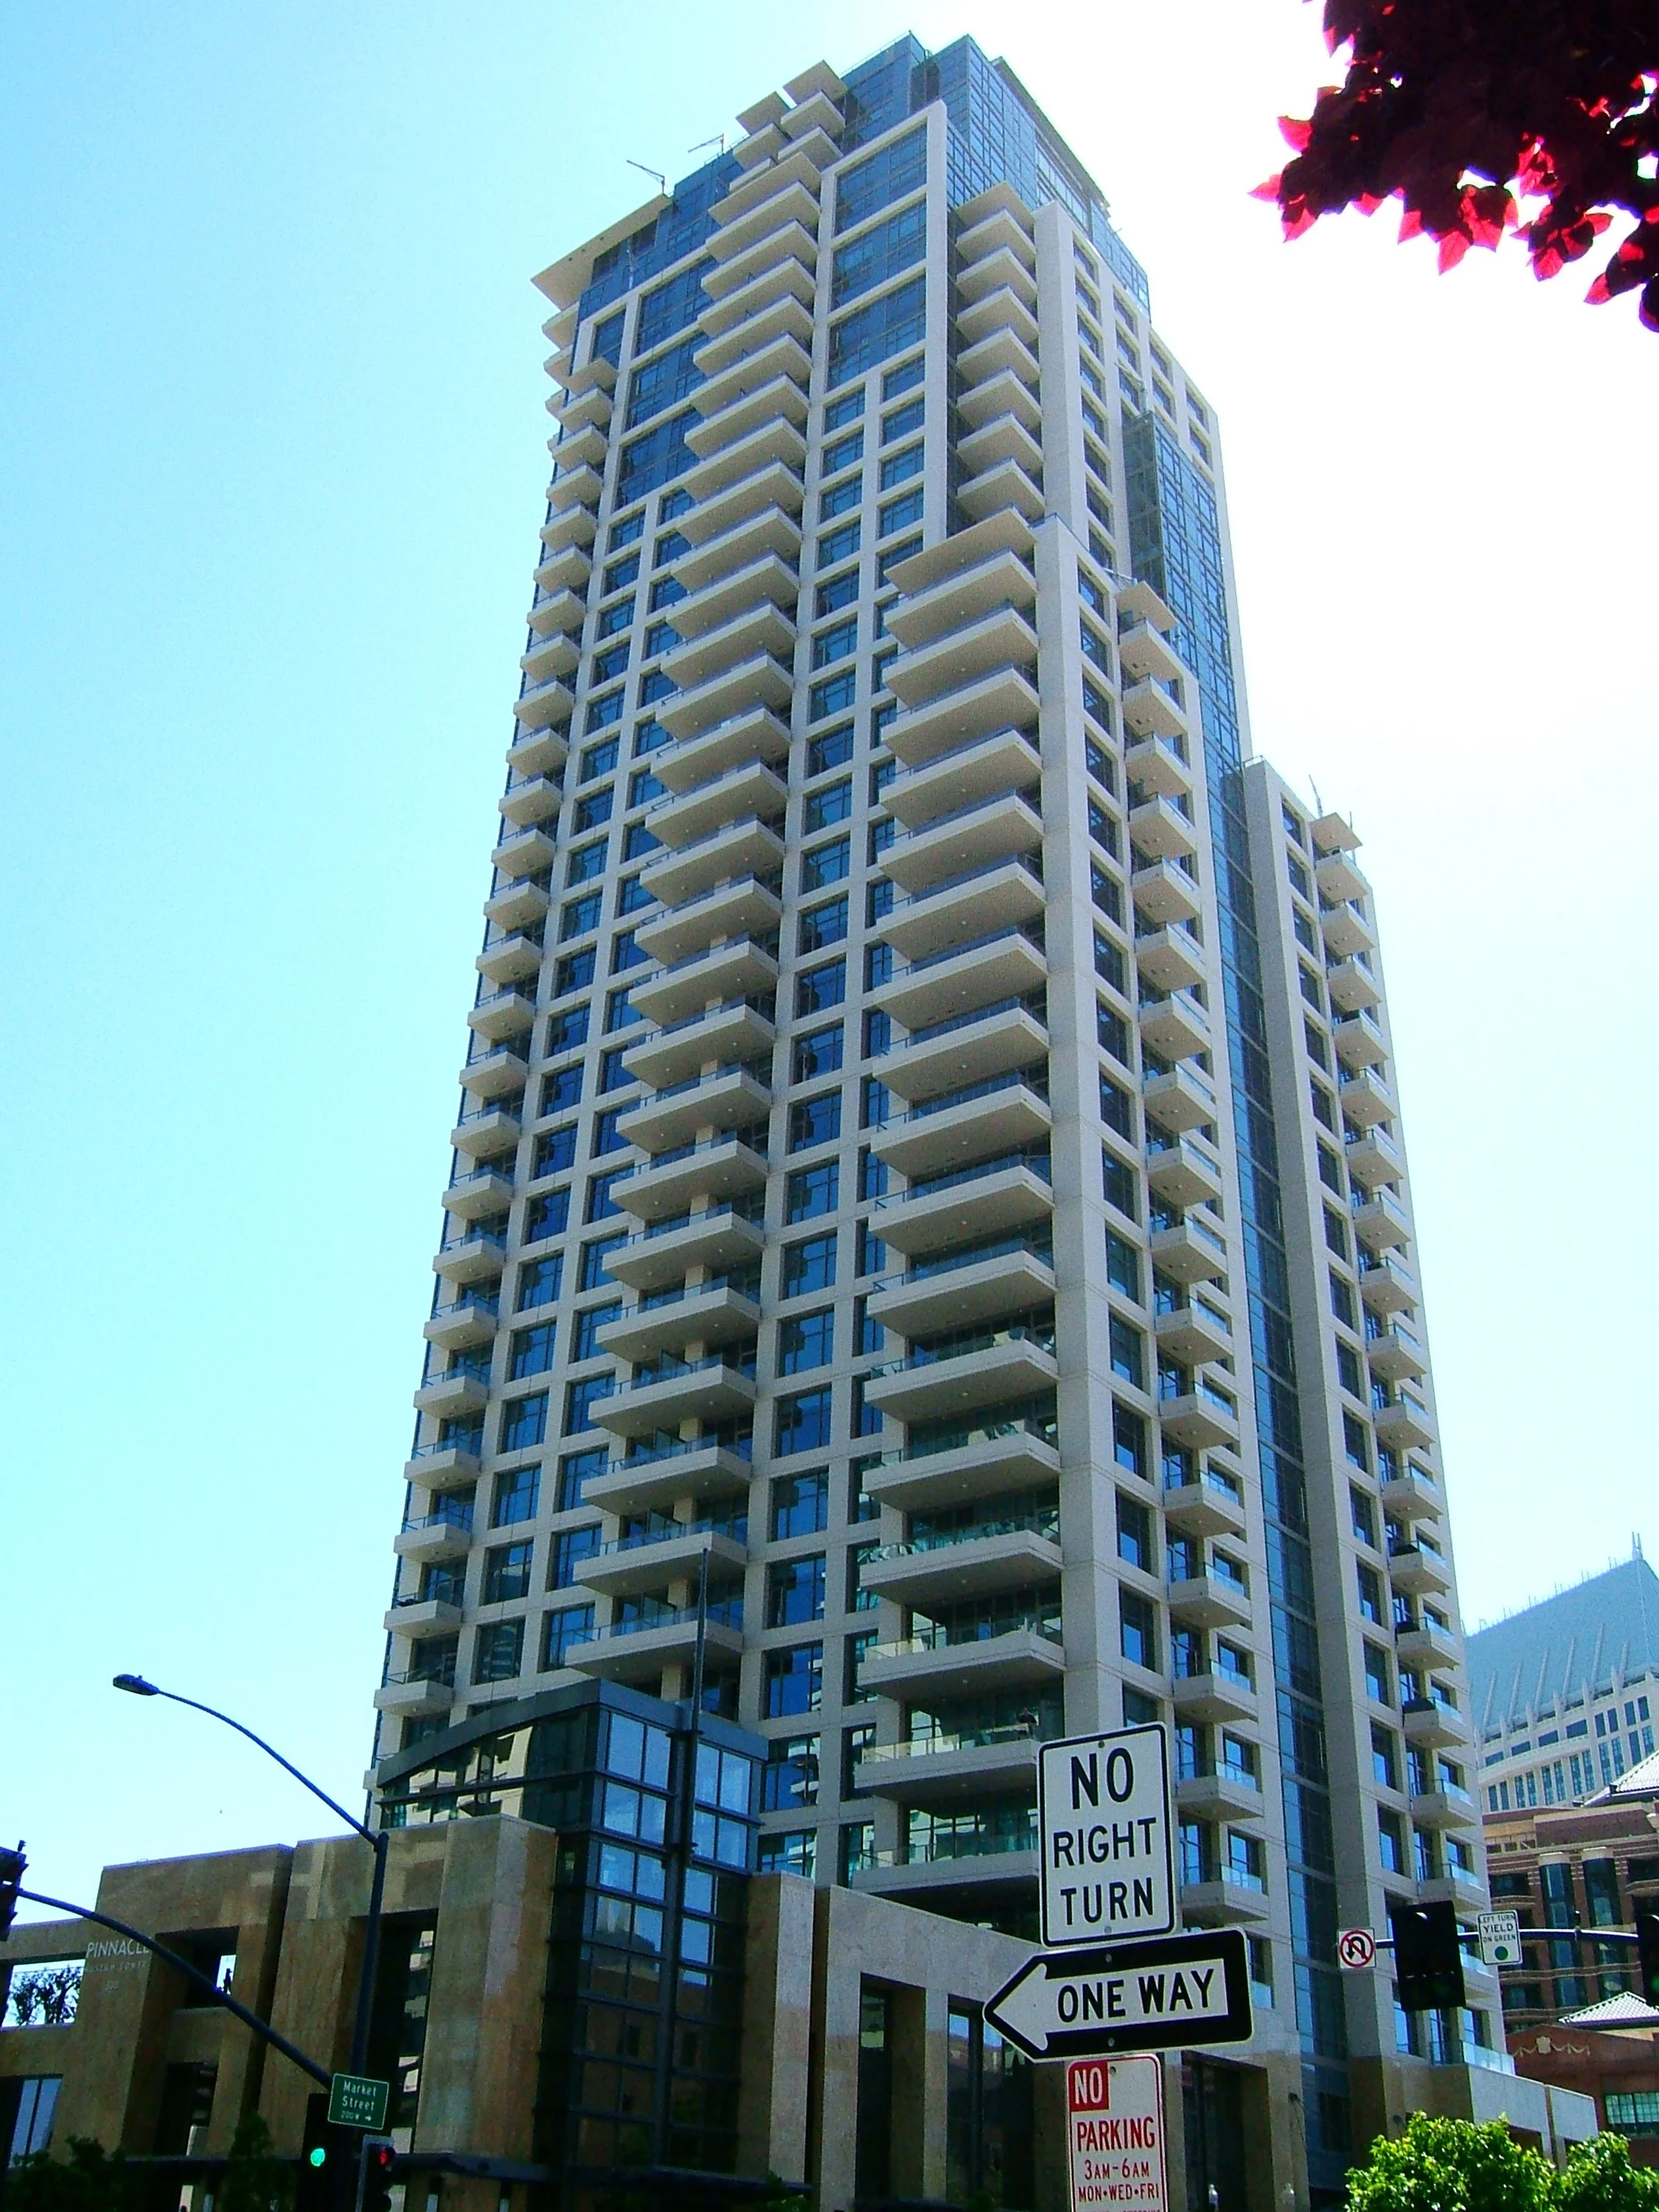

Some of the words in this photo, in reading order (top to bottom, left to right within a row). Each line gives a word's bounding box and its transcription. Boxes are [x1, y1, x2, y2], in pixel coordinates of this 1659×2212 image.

[1071, 1748, 1134, 1810] NO
[1053, 1817, 1156, 1868] RIGHT
[1060, 1877, 1153, 1925] TURN
[1483, 1923, 1514, 1933] YIELD
[1058, 1980, 1126, 2022] ONE
[1138, 1969, 1214, 2014] WAY
[342, 2095, 374, 2111] Street
[343, 2080, 377, 2097] Market
[1075, 2067, 1103, 2105] NO
[1076, 2116, 1156, 2152] PARKING
